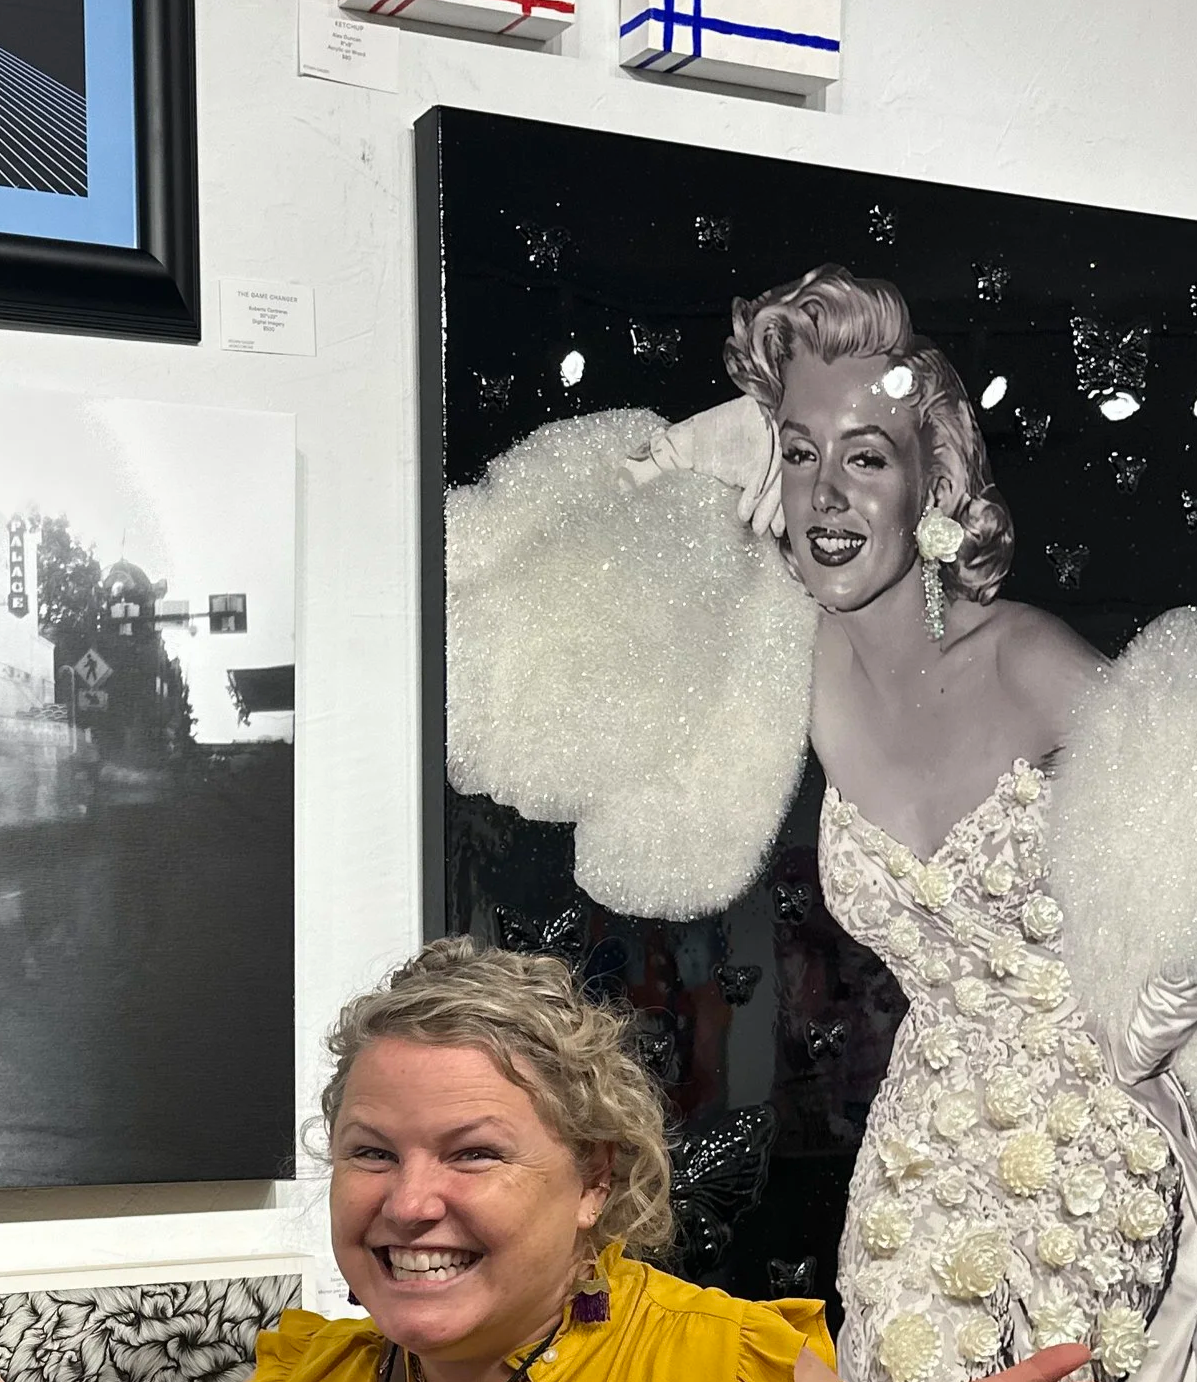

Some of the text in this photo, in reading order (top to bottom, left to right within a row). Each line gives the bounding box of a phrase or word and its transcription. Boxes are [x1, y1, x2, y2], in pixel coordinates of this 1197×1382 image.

[335, 21, 364, 31] KETCHUP
[269, 294, 298, 303] CHANGER
[9, 520, 25, 610] PALACE
